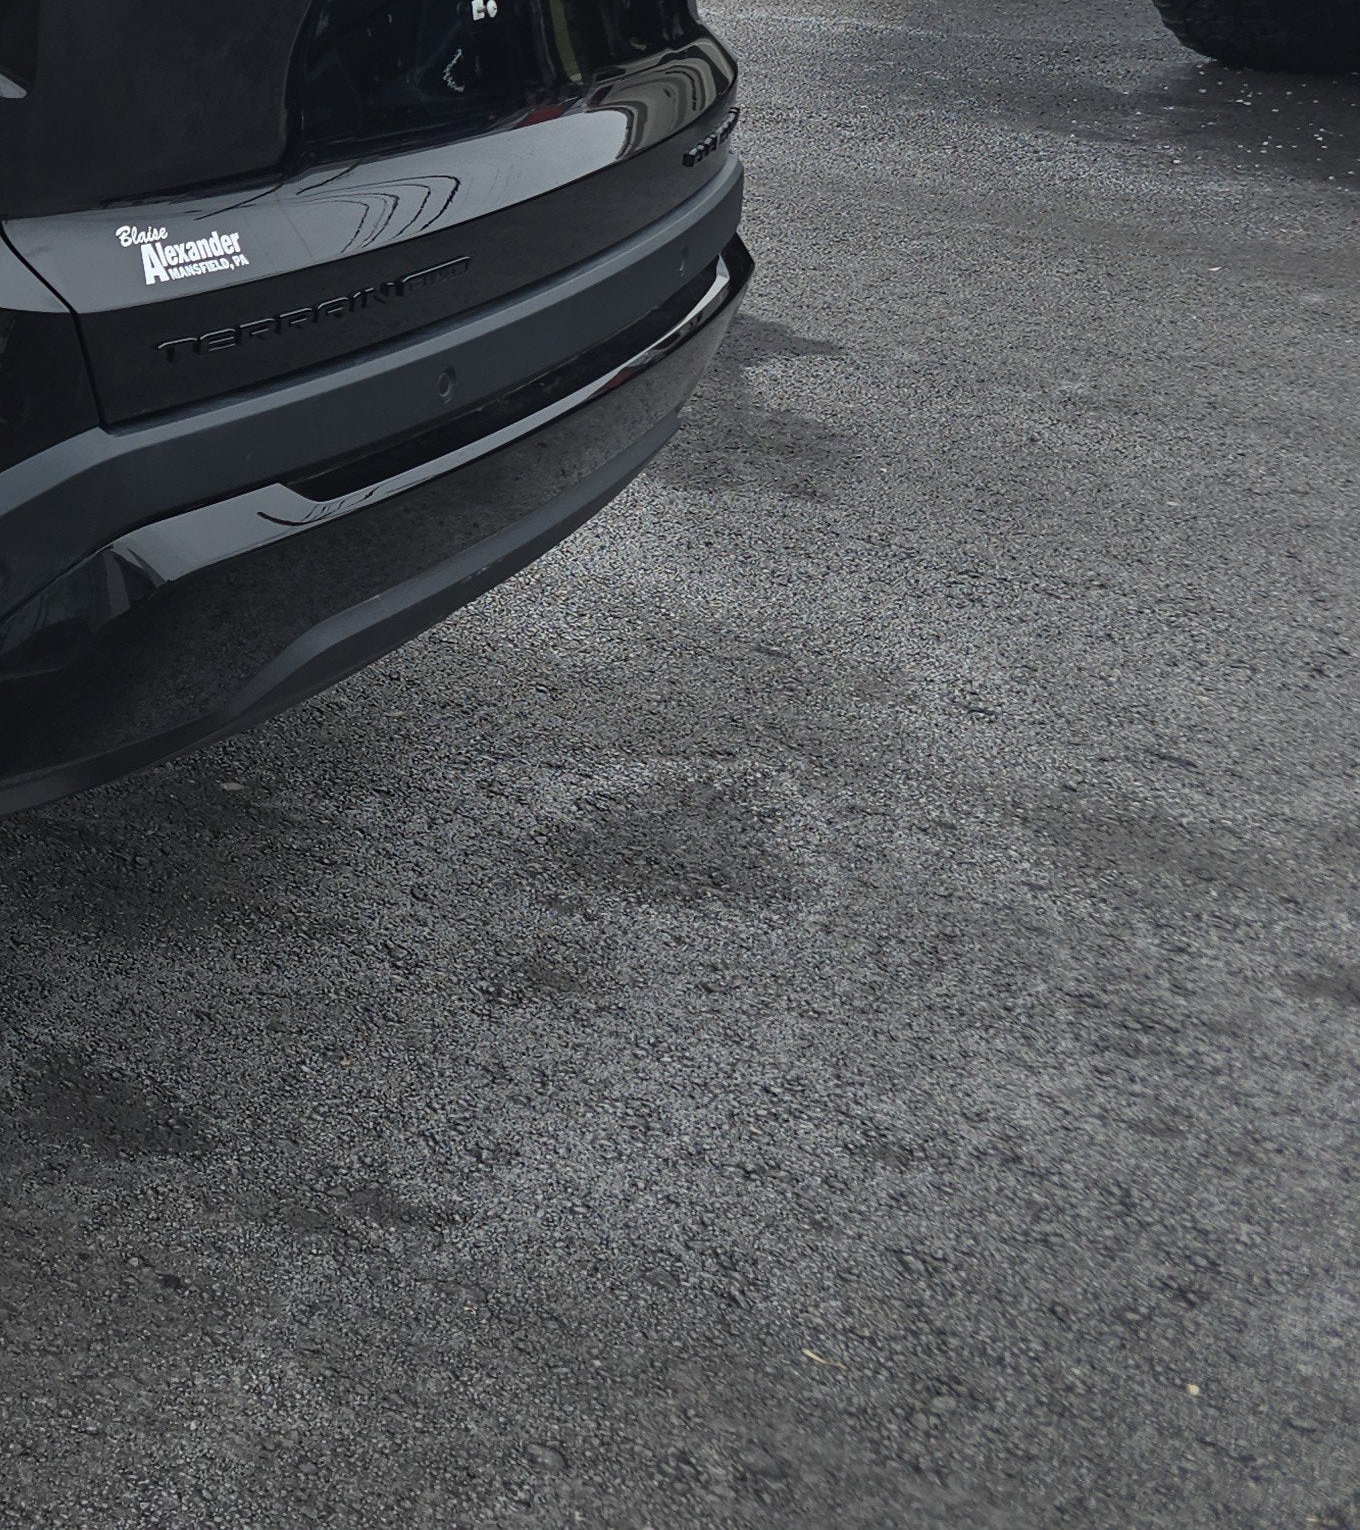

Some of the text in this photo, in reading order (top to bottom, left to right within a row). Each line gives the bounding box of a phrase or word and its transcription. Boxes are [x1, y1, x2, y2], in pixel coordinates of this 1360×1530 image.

[115, 224, 169, 248] Blaise
[140, 230, 241, 286] Alexander
[167, 253, 250, 281] MANSFIELD, PA
[155, 281, 404, 363] TERRAIN
